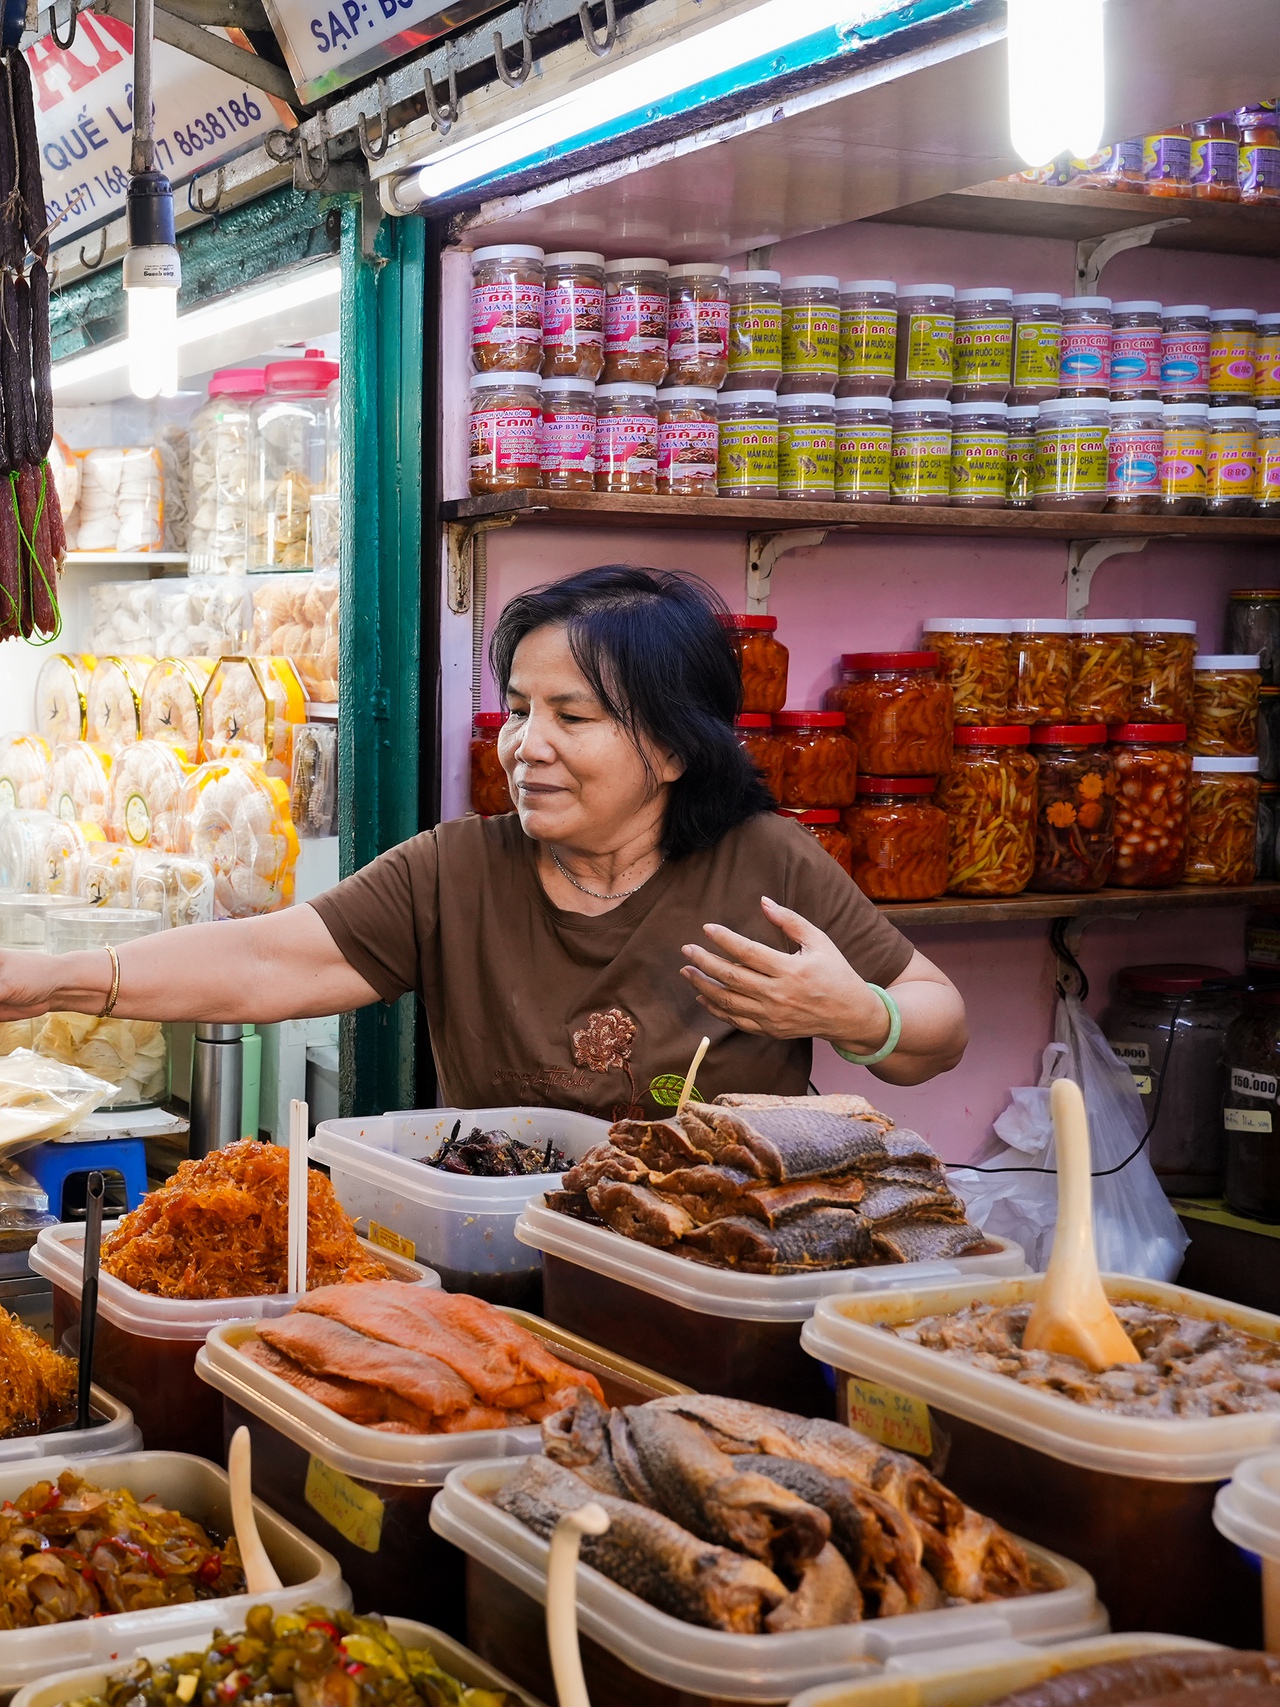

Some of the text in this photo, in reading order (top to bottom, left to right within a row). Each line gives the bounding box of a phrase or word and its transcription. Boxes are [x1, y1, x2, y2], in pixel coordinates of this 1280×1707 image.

[43, 105, 109, 171] QUẾ
[93, 165, 130, 199] 168
[173, 92, 263, 157] 8638186
[763, 320, 777, 328] BA
[814, 321, 828, 331] BÀ
[871, 326, 885, 334] BA
[956, 334, 971, 345] BÀ
[976, 334, 991, 343] BA
[1071, 337, 1108, 346] BA CAM
[1114, 340, 1154, 350] BA CAM
[1167, 344, 1205, 353] BA CAM
[496, 419, 534, 427] CAM
[509, 428, 536, 436] XAY
[743, 434, 774, 444] BÀ BA
[813, 438, 827, 448] BÀ
[840, 441, 875, 450] BÀ BA
[1042, 442, 1103, 453] BÀ BA CAM
[892, 446, 906, 456] BÀ
[966, 446, 999, 456] BÀ BA
[1233, 1074, 1276, 1094] 150.000
